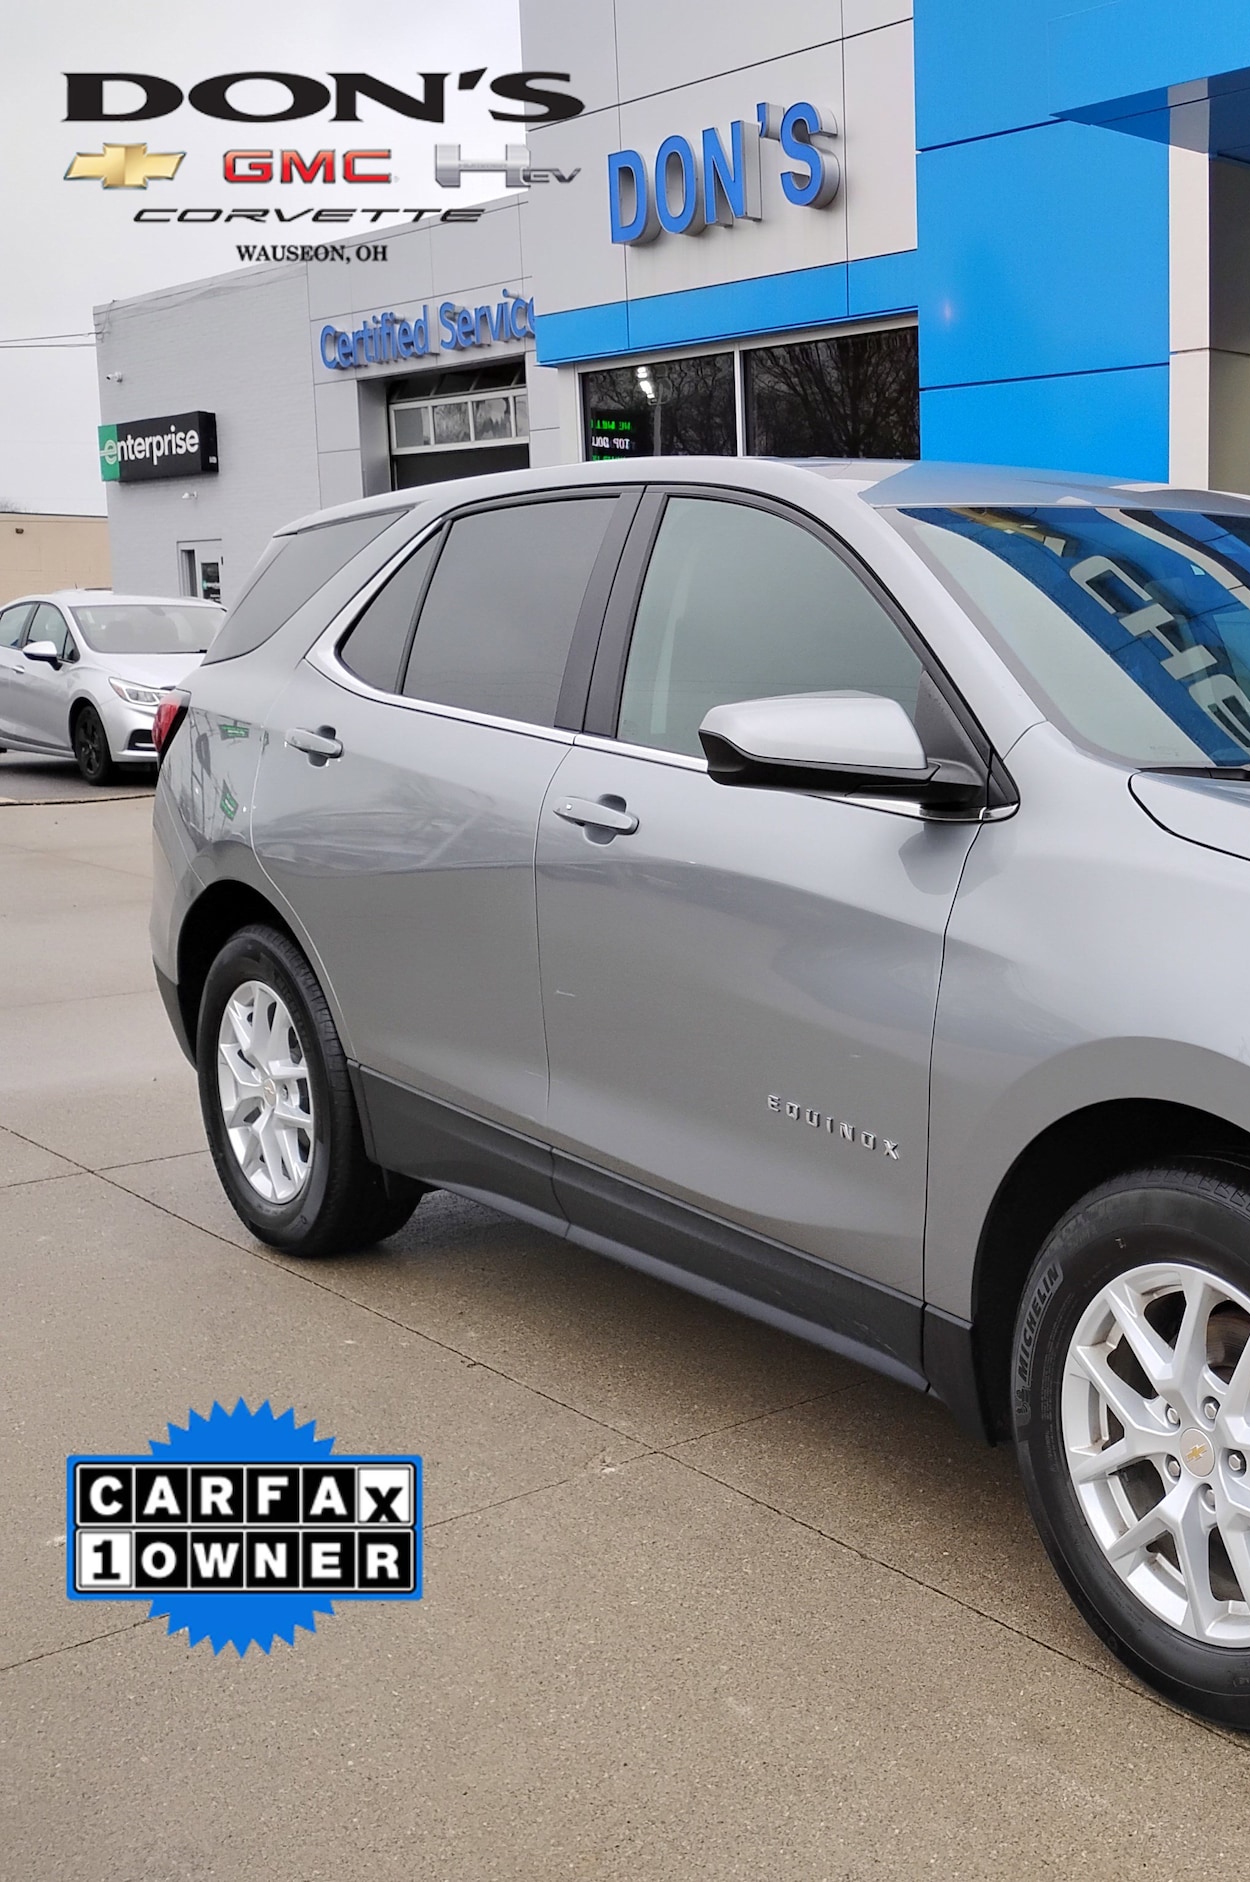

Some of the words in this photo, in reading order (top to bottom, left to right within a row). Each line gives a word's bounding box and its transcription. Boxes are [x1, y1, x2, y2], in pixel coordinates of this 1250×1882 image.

[608, 102, 836, 244] DON'S
[320, 304, 431, 370] Certified
[99, 424, 200, 466] enterprise
[767, 1094, 900, 1160] EQUINOX
[1017, 1261, 1060, 1383] MICHELIN
